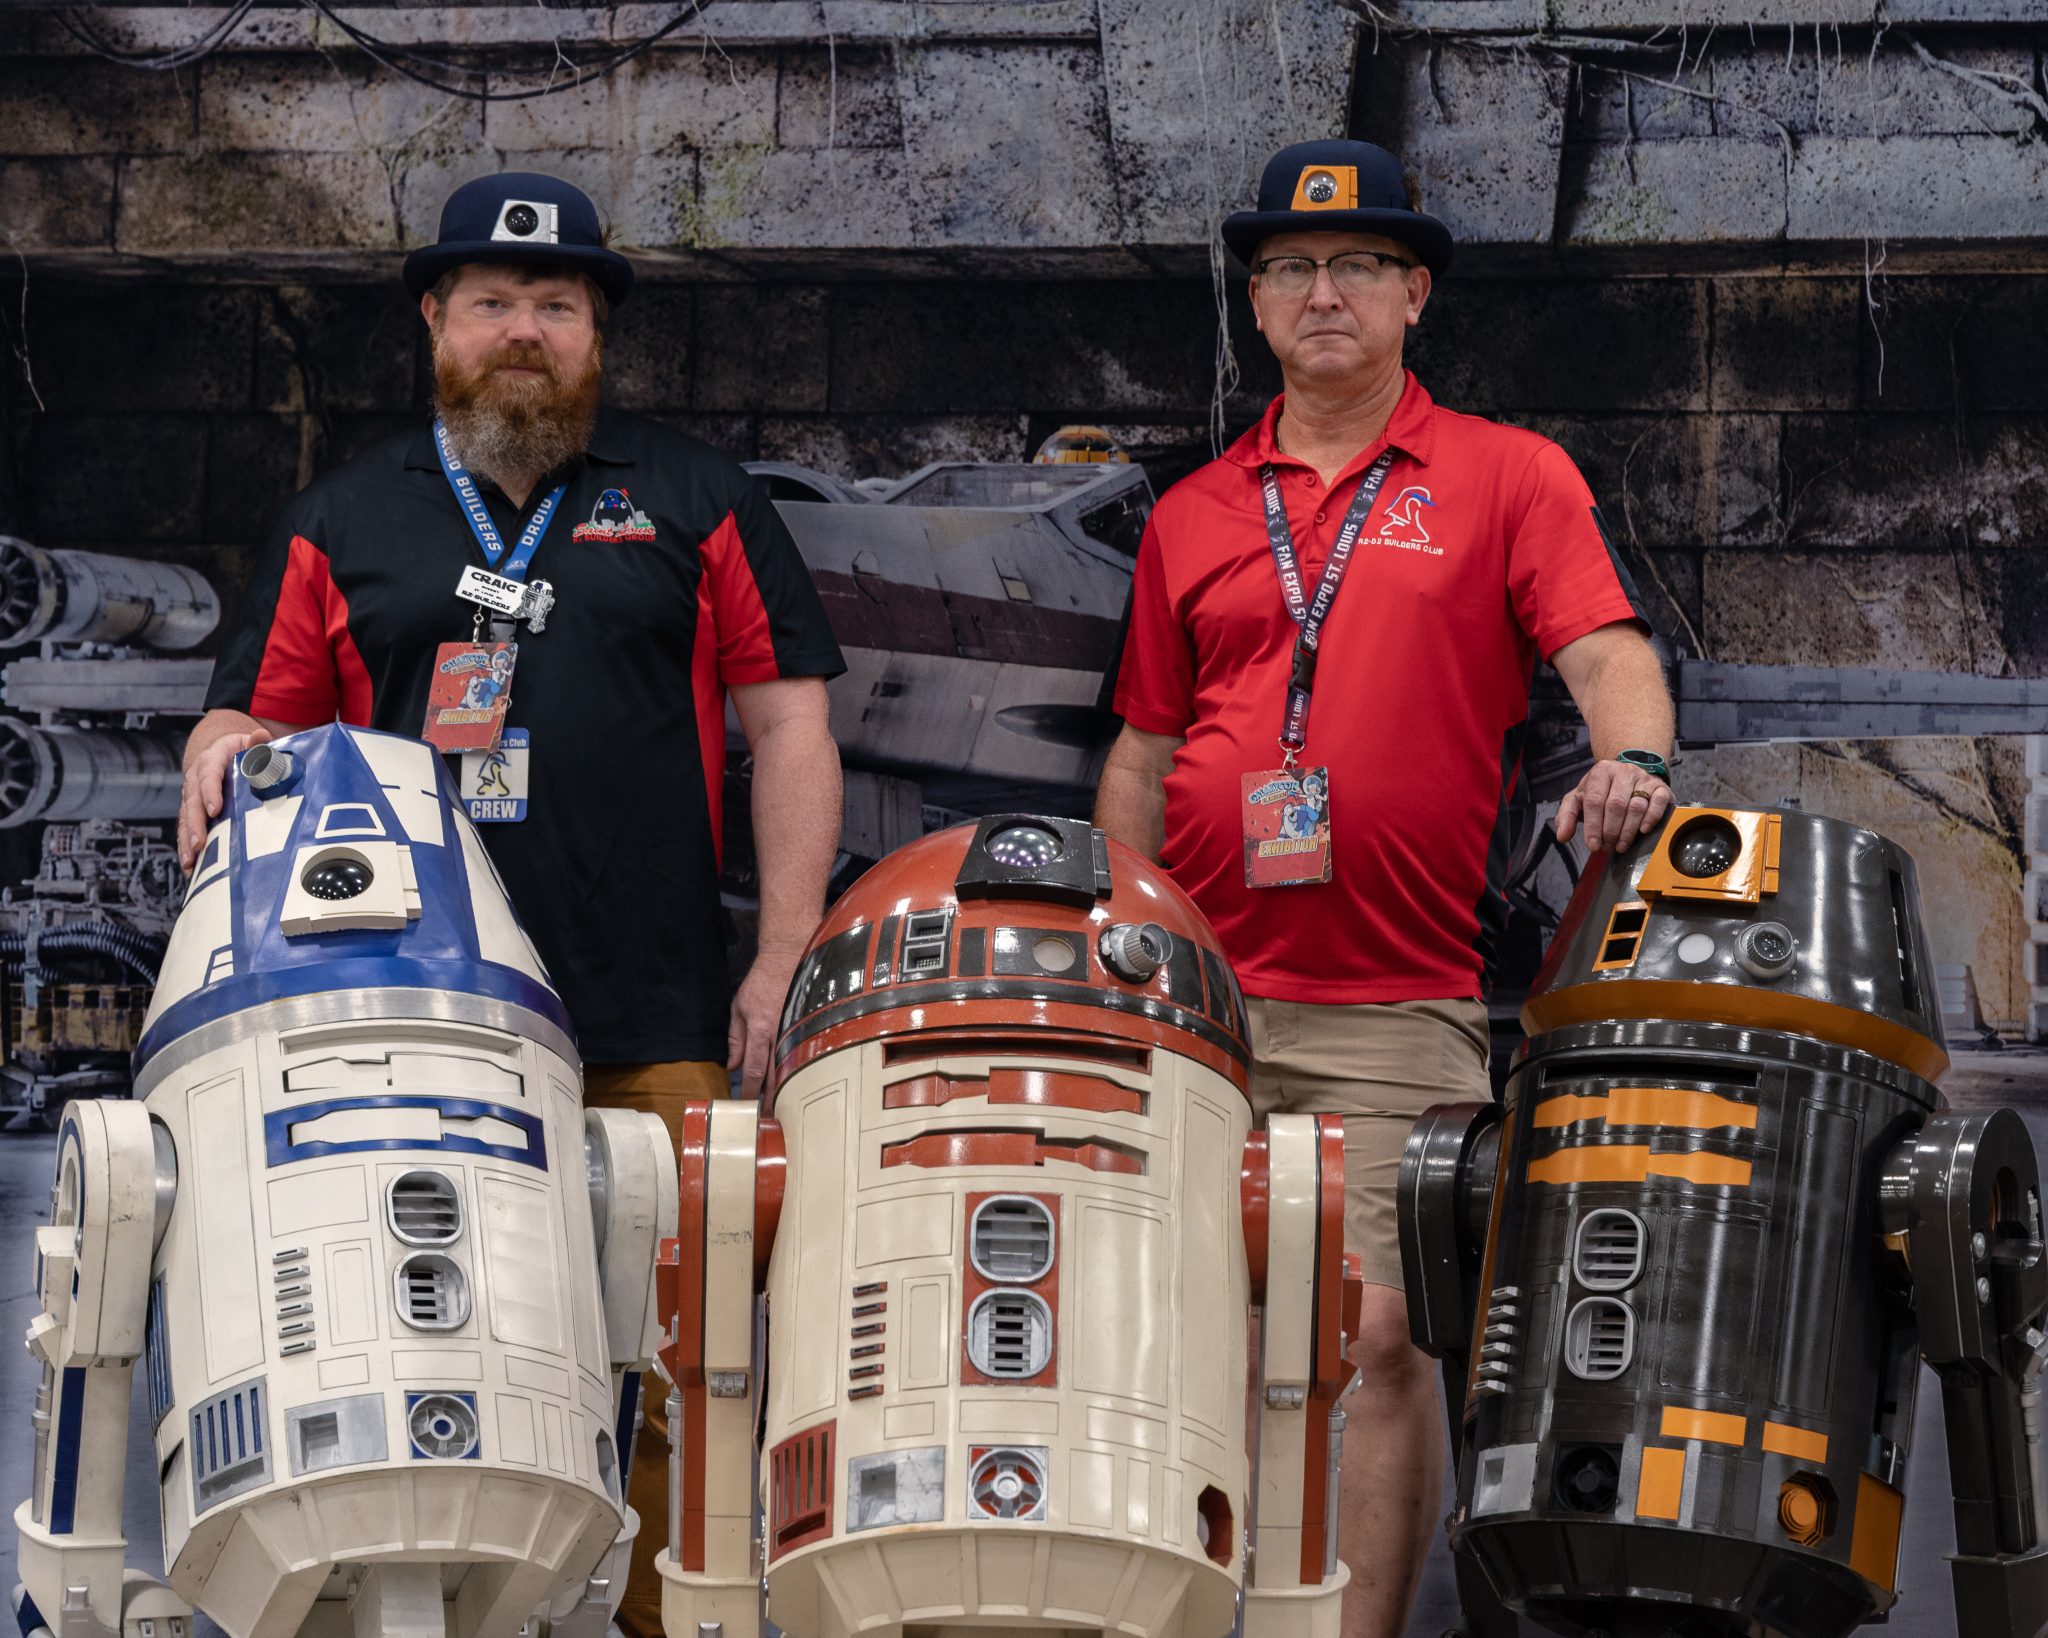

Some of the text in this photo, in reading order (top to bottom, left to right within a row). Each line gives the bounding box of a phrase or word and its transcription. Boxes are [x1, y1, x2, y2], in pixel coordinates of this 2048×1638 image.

[1365, 466, 1385, 490] FAN
[1264, 481, 1281, 515] LOUIS
[456, 476, 502, 551] BUILDERS
[521, 498, 553, 547] DROID
[584, 533, 623, 544] BUILDERS
[624, 533, 657, 543] GROUP
[1333, 523, 1359, 560] LOUIS
[1358, 537, 1444, 556] R2-D2 BUILDERS CLUB
[1276, 544, 1295, 570] FAN
[471, 571, 518, 594] CRAIG
[1282, 571, 1303, 604] EXPO
[1311, 583, 1335, 620] EXPO
[1304, 618, 1319, 646] FAN
[1293, 693, 1305, 718] LOUIS
[509, 738, 527, 748] Club
[470, 800, 518, 819] CREW
[1258, 836, 1319, 857] EXHIBITOR
